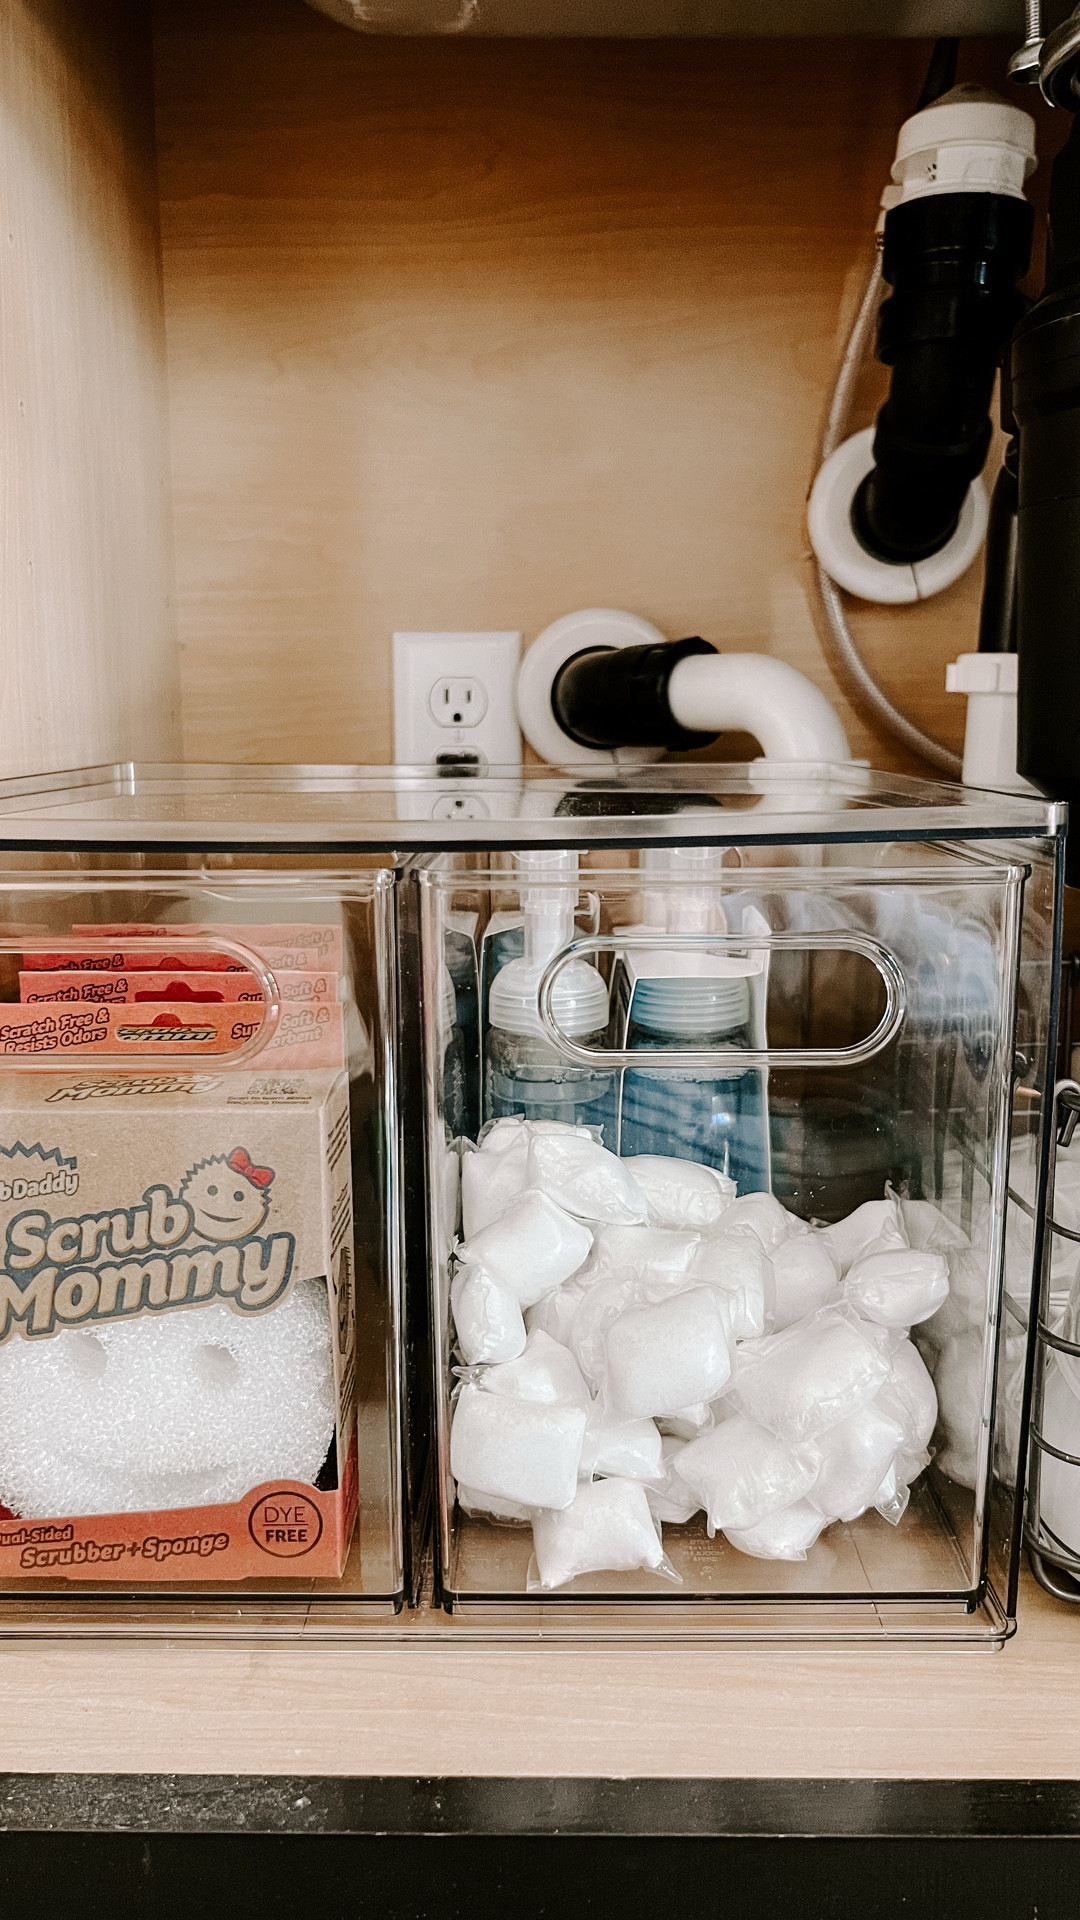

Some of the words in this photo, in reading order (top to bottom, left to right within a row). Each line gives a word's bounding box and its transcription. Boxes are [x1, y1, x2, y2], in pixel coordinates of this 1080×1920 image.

[112, 953, 125, 968] &
[82, 983, 114, 999] Free
[114, 978, 128, 993] &
[282, 981, 313, 998] Soft
[313, 978, 327, 993] &
[0, 1017, 56, 1041] Scratch
[59, 1013, 94, 1031] Free
[95, 1007, 110, 1024] &
[281, 1010, 315, 1030] Soft
[316, 1007, 331, 1023] &
[5, 1036, 58, 1053] Resists
[60, 1027, 108, 1046] Odors
[45, 1081, 225, 1103] Mommy
[5, 1184, 196, 1270] Scrub
[0, 1231, 295, 1337] Mommy
[264, 1506, 306, 1523] DYE
[0, 1524, 74, 1546] ual-Sided
[265, 1529, 308, 1543] FREE
